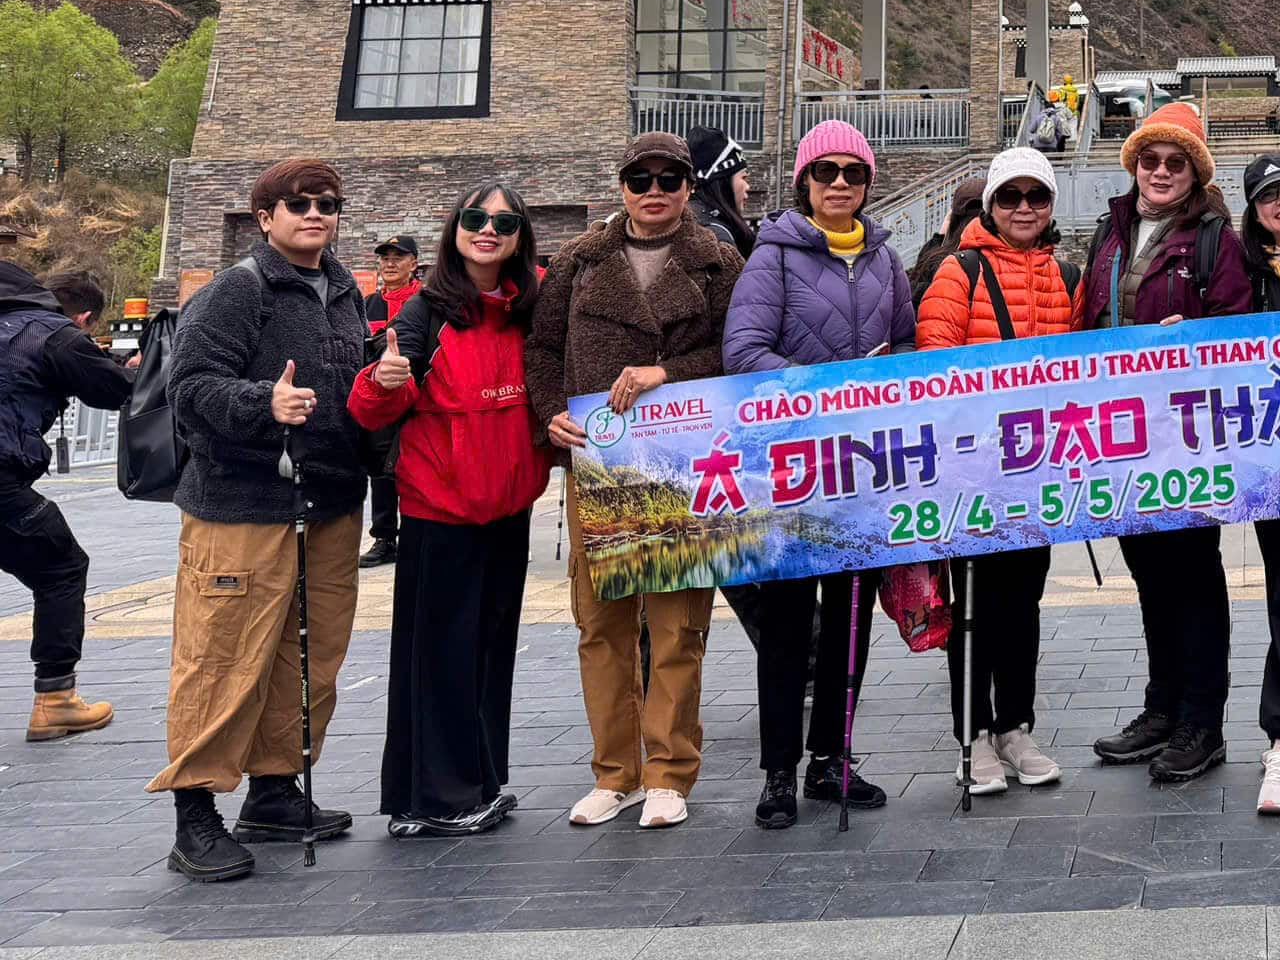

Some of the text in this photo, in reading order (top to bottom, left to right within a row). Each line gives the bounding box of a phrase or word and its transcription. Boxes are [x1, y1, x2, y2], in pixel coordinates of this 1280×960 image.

[738, 393, 812, 423] CHÀO
[821, 383, 900, 412] MỪNG
[908, 368, 984, 401] ĐOÀN
[992, 357, 1080, 390] KHÁCH
[1087, 357, 1097, 378] J
[1105, 348, 1190, 376] TRAVEL
[1196, 340, 1267, 366] THAM
[692, 431, 747, 513] Á
[768, 423, 940, 503] ĐINH
[955, 434, 975, 449] -
[1000, 396, 1147, 478] ĐẠO
[888, 464, 1236, 541] 28/4 - 5/5/2025
